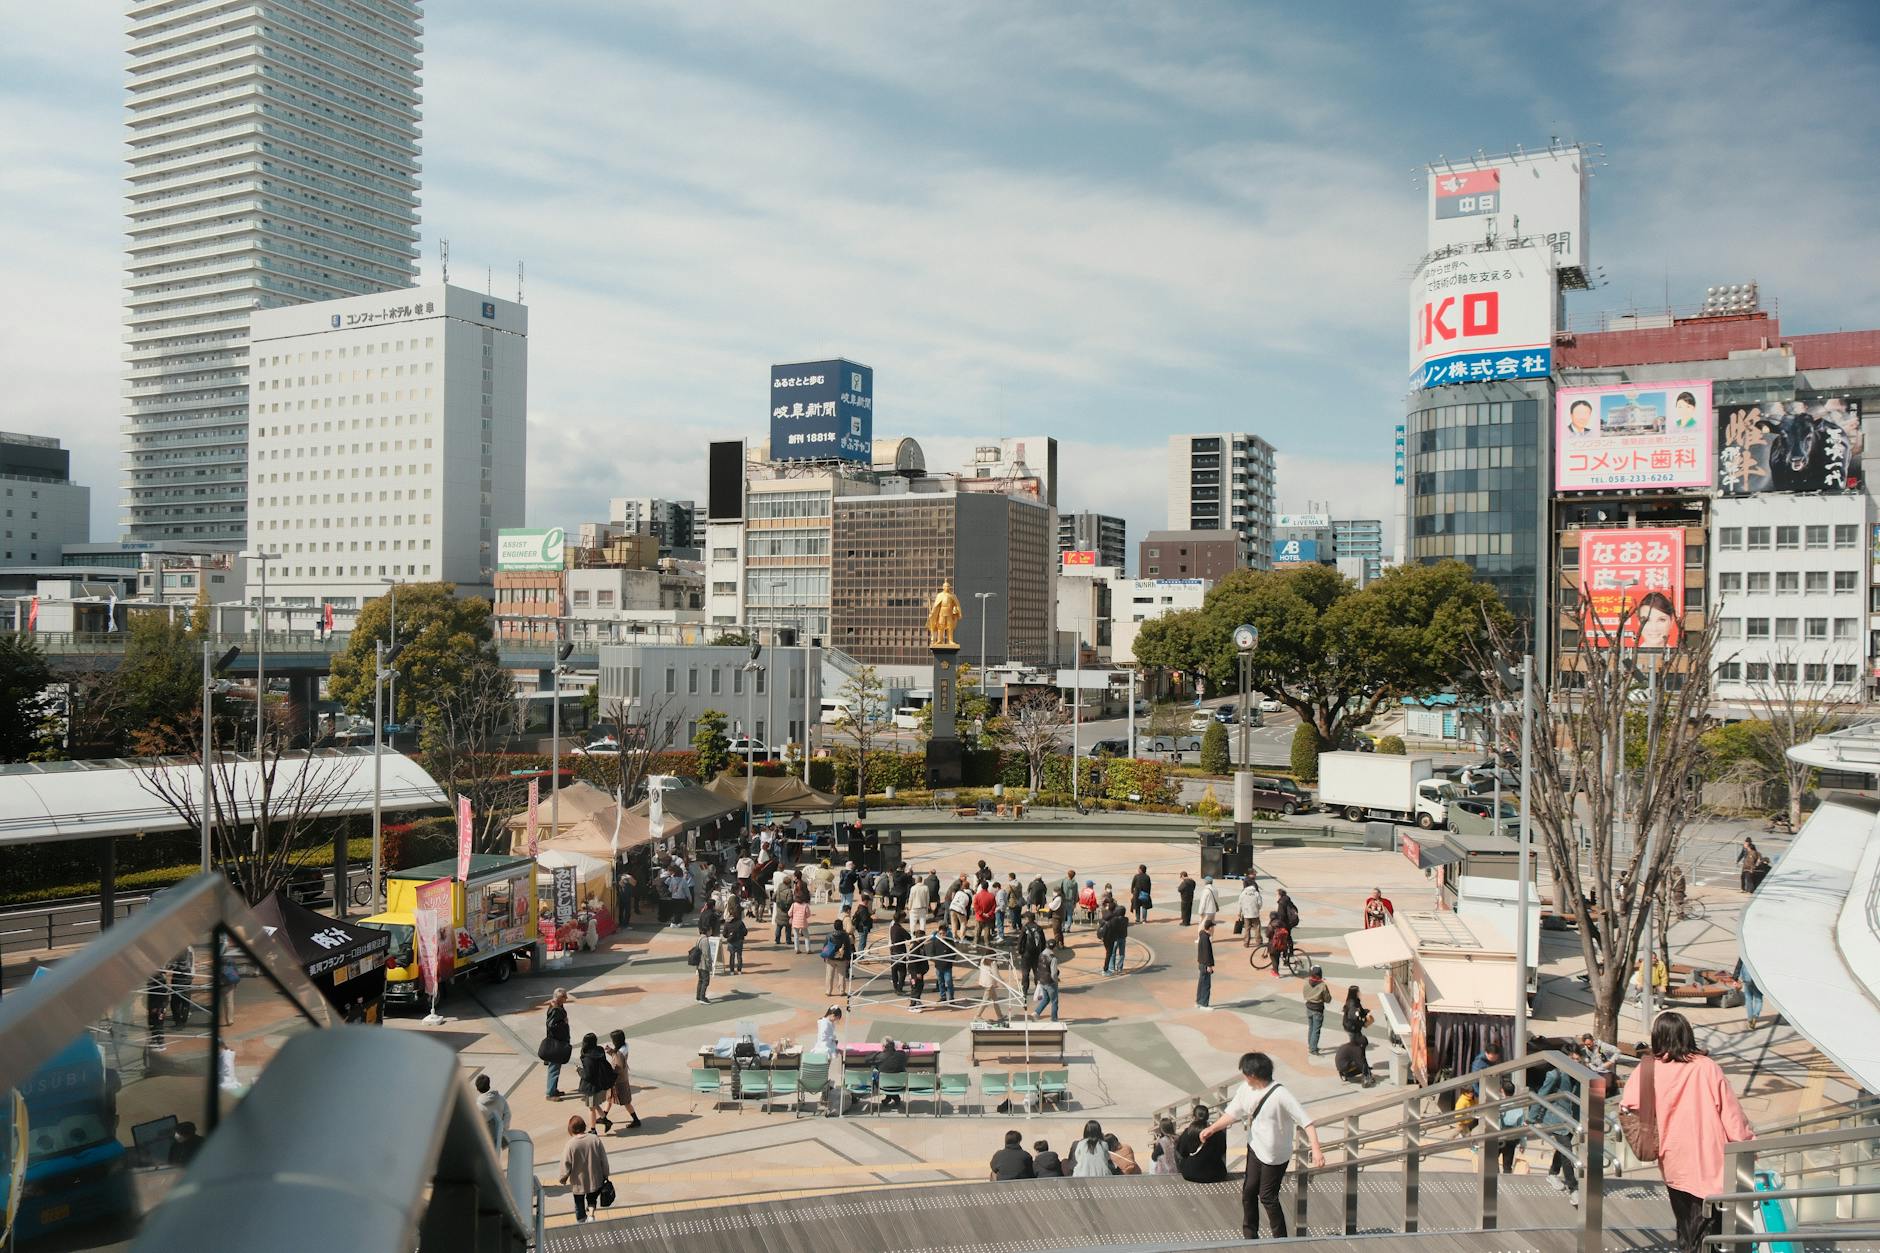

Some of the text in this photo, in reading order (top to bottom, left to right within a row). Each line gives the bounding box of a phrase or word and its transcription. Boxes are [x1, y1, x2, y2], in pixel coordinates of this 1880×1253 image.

[1459, 195, 1494, 212] 中日
[774, 376, 824, 388] ふるさとと歩む
[773, 401, 836, 419] 岐阜新聞
[788, 432, 836, 444] 創刊 1881年
[1568, 448, 1697, 472] コメット歯科
[503, 541, 527, 549] ASSIST
[1281, 541, 1300, 554] AB
[1592, 541, 1670, 563] なおみ
[1592, 567, 1670, 590] 皮フ科
